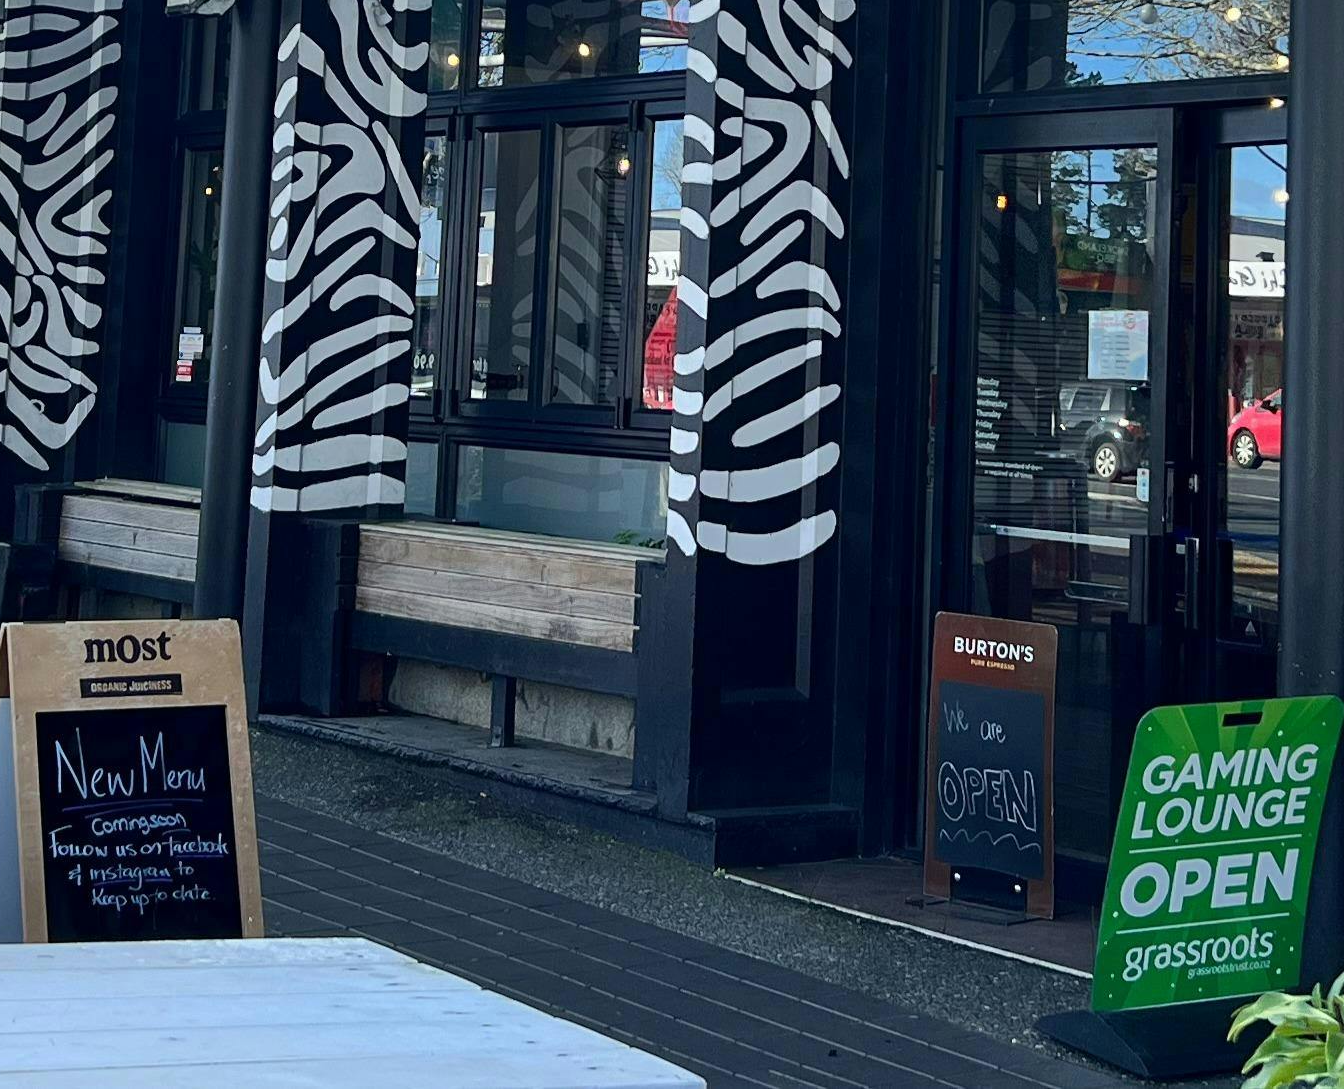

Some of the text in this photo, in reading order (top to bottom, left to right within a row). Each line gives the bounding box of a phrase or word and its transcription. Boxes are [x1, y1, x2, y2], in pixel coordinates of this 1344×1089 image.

[953, 636, 1035, 663] BURTON'S
[970, 658, 1015, 671] PURE ESPRESSO
[90, 679, 172, 693] ORGANIC JUICINESS
[943, 701, 1006, 743] We are
[55, 727, 206, 800] New Menu
[1141, 744, 1320, 795] GAMING
[937, 761, 1037, 833] OPEN
[1131, 786, 1311, 840] LOUNGE
[115, 843, 137, 857] us
[140, 841, 162, 855] on
[173, 860, 194, 876] to
[1120, 848, 1300, 918] OPEN
[130, 893, 150, 915] up
[150, 888, 168, 901] to
[1122, 927, 1274, 982] grassroots
[1187, 959, 1271, 980] grassrootstrust.co.nz
